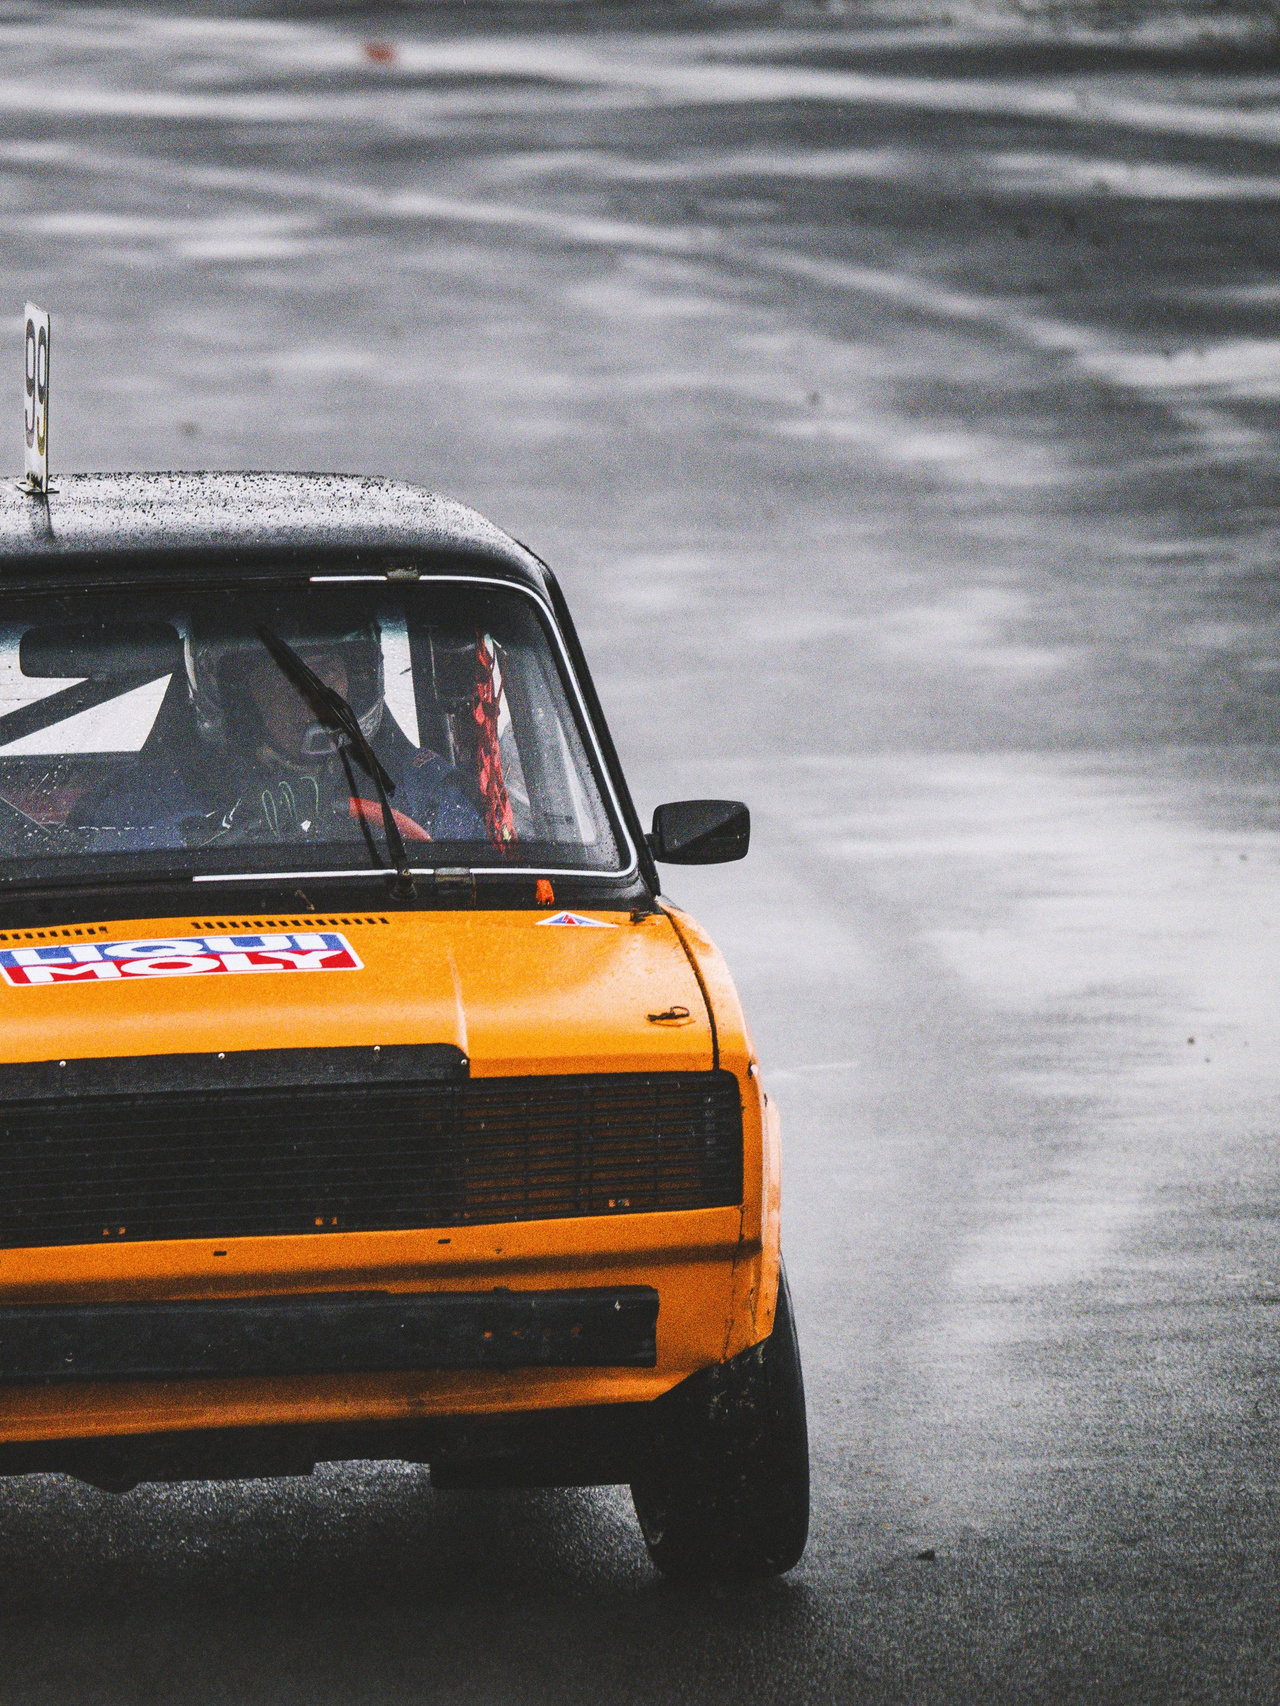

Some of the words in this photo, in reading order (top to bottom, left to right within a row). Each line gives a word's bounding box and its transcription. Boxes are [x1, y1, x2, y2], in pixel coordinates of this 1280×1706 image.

[25, 318, 47, 457] 99
[11, 934, 329, 966] LIQUI
[22, 949, 343, 984] MOLY
